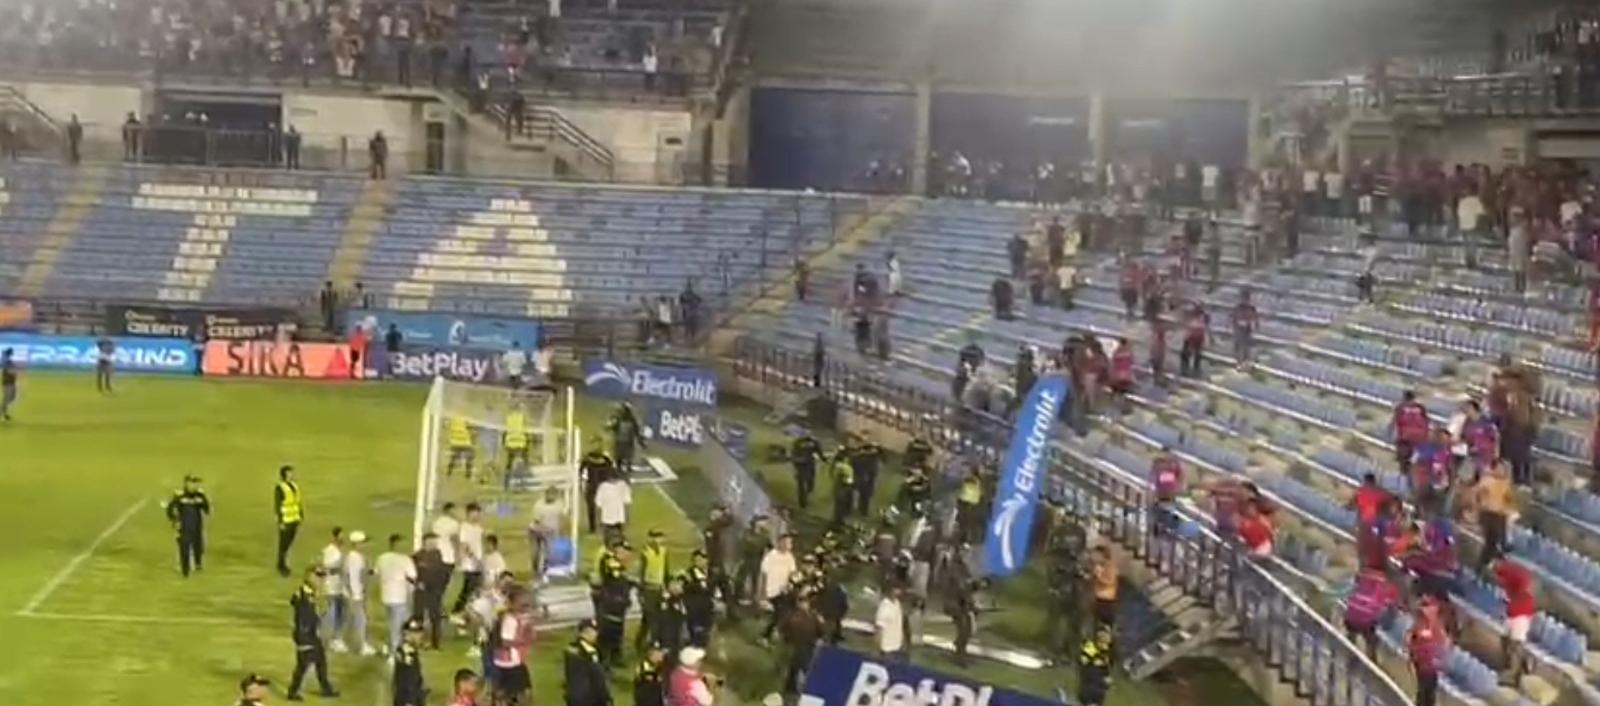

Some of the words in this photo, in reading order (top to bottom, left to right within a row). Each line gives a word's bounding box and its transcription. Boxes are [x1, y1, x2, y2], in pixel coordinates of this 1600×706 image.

[391, 352, 489, 382] BetPlay
[631, 370, 717, 405] Electrolit
[1014, 390, 1058, 493] Electrolit
